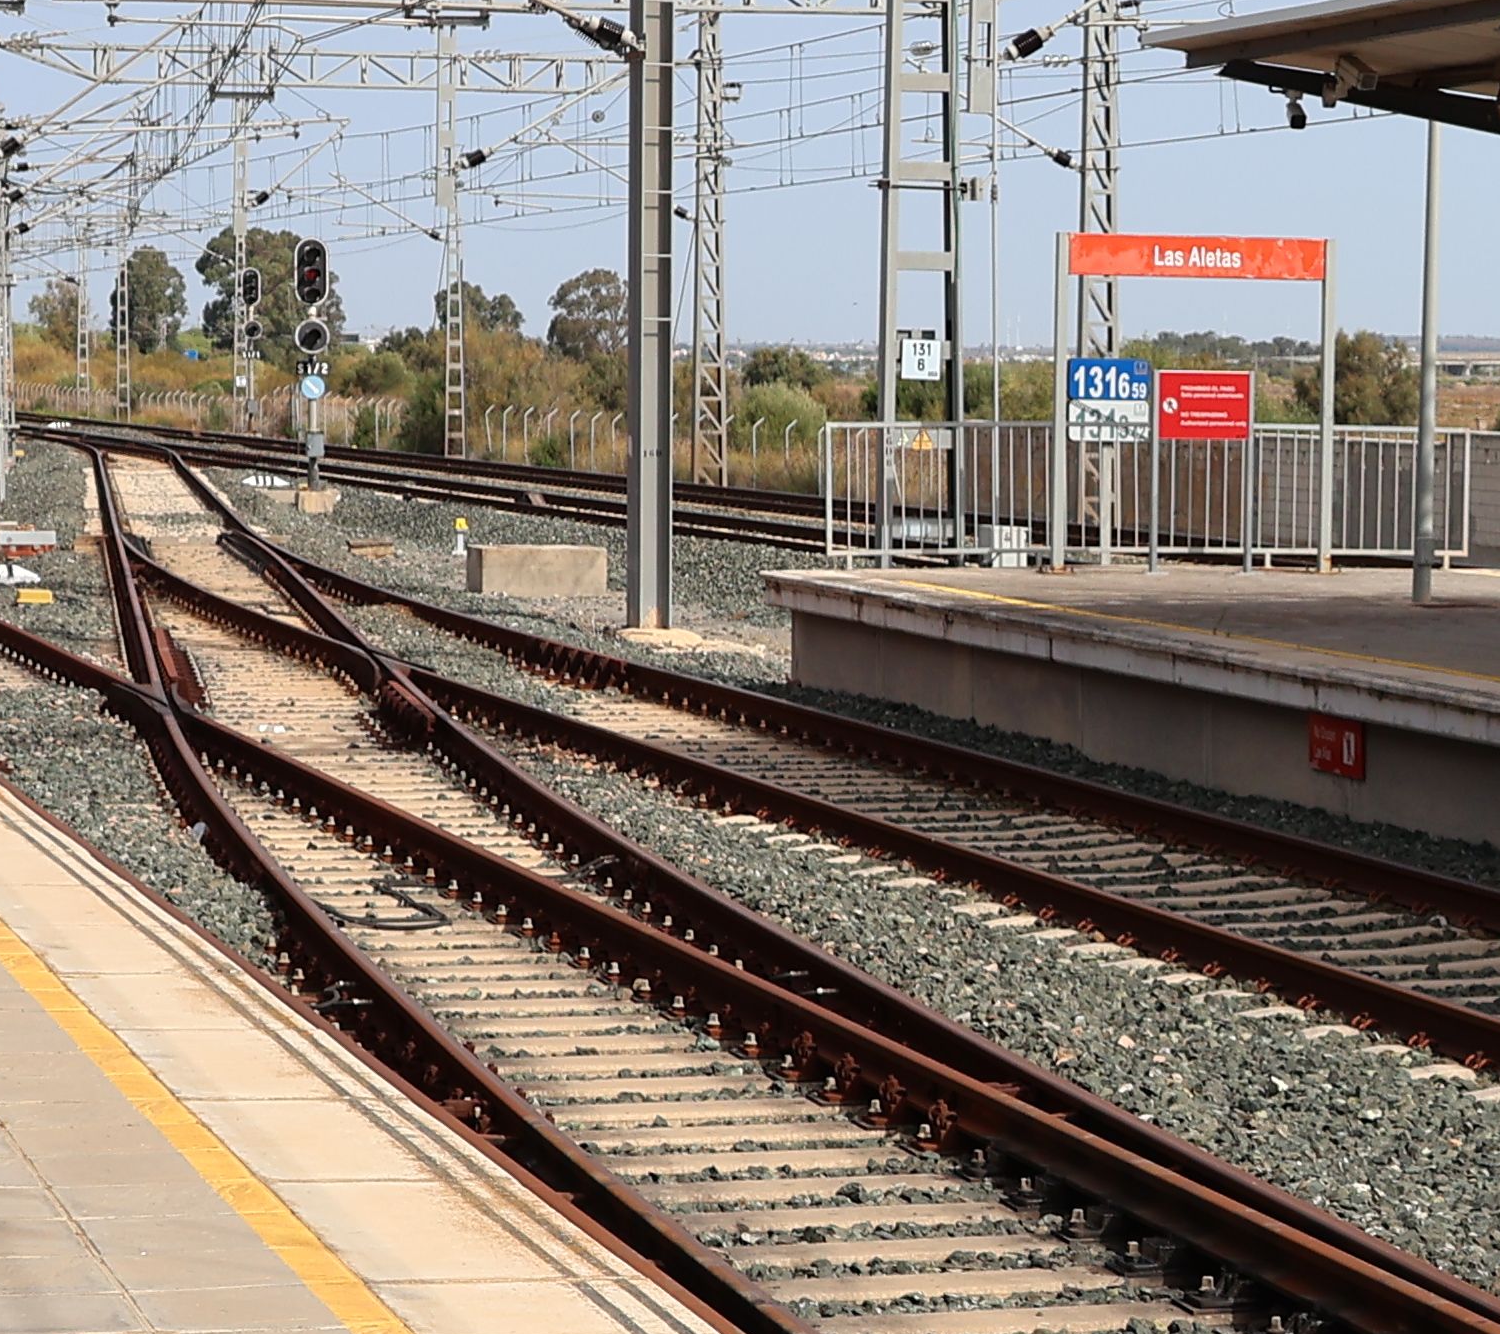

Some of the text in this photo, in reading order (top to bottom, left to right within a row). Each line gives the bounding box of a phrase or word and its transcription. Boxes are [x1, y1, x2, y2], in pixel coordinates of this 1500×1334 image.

[1154, 245, 1241, 268] Las Aletas
[913, 342, 931, 357] 131
